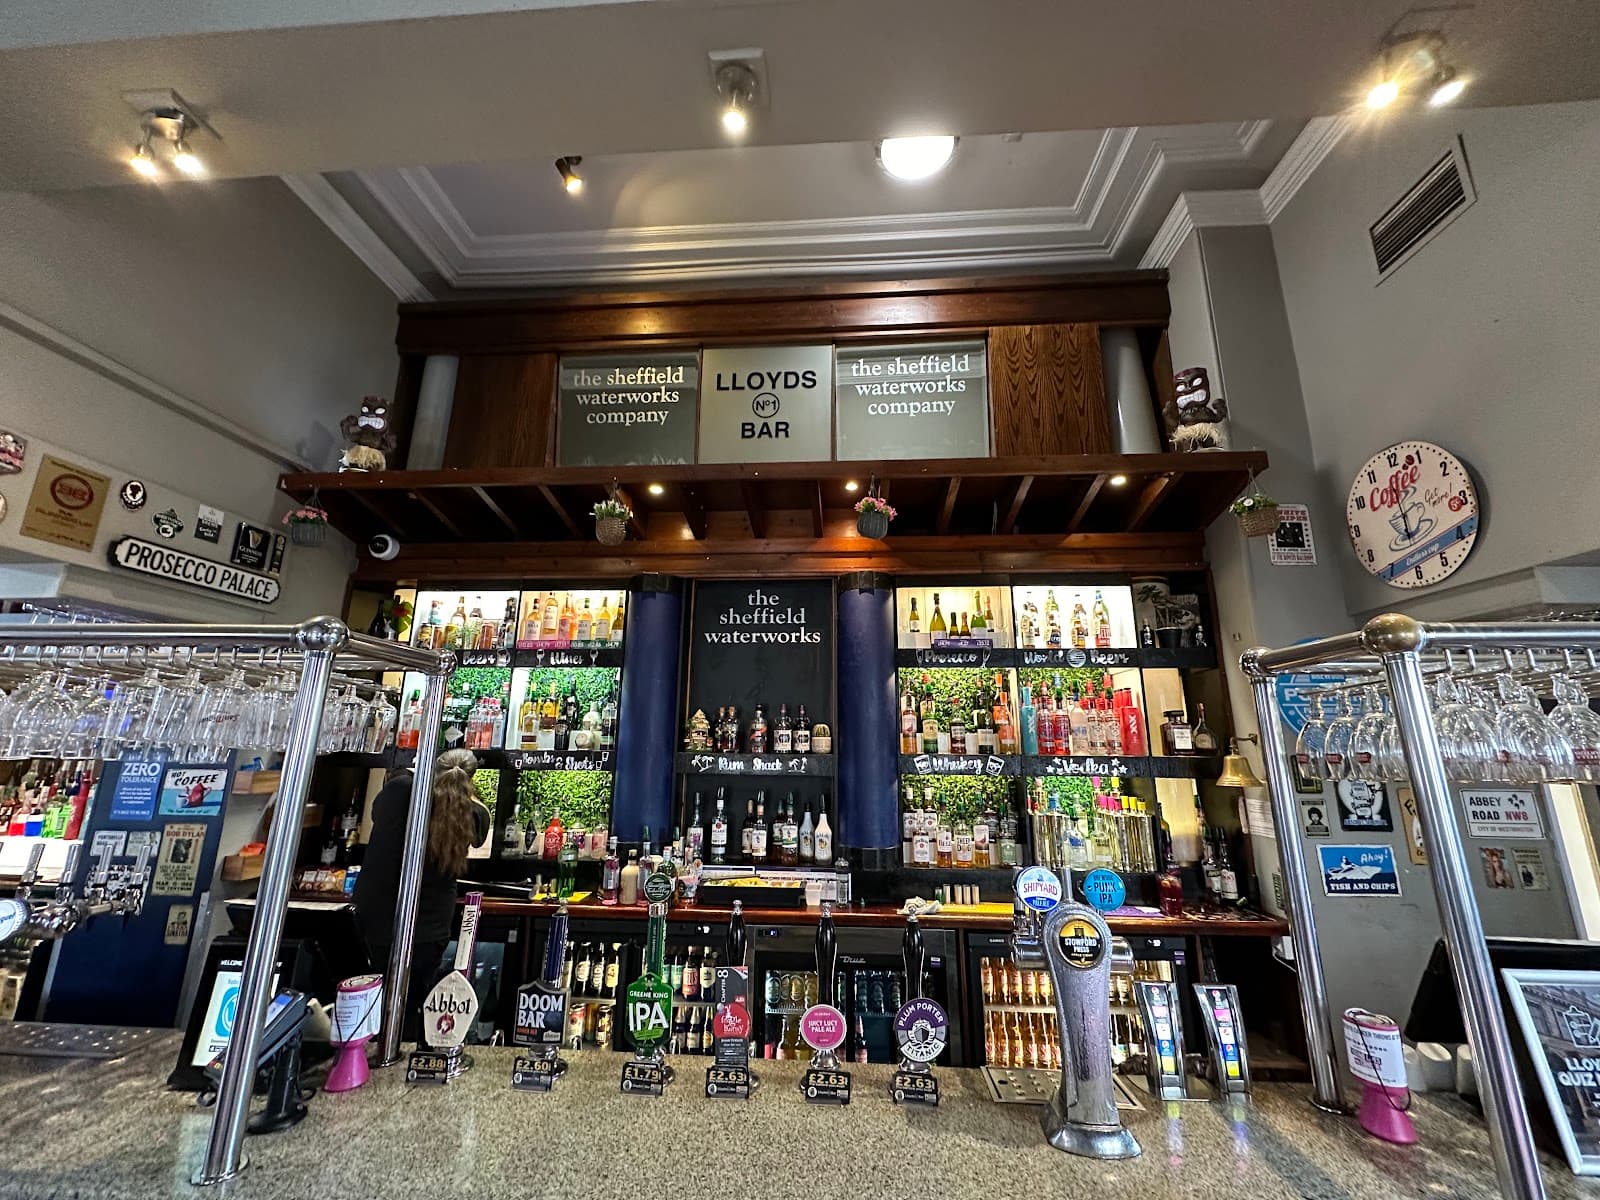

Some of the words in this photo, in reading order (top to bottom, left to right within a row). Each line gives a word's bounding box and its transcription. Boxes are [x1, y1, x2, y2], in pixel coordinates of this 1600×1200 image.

[850, 360, 882, 377] the
[886, 354, 970, 375] sheffield
[573, 370, 603, 387] the
[605, 366, 684, 385] sheffield
[715, 370, 818, 392] LLOYDS
[854, 374, 967, 396] waterworks
[576, 385, 680, 405] waterworks
[866, 397, 957, 418] company
[586, 406, 669, 427] company
[740, 420, 790, 440] BAR
[1386, 453, 1399, 468] 12
[1415, 450, 1422, 465] 1
[1440, 461, 1450, 477] 2
[1366, 470, 1377, 485] 11
[1369, 465, 1421, 512] Coffee
[1354, 496, 1366, 511] 10
[1458, 490, 1469, 506] 3
[1353, 524, 1361, 538] 9
[1455, 526, 1465, 541] 4
[1367, 549, 1375, 563] 8
[1439, 551, 1449, 567] 5
[124, 542, 218, 586] PROSECCO
[218, 568, 273, 600] PALACE
[1388, 563, 1395, 578] 7
[1414, 564, 1423, 580] 6
[747, 588, 780, 606] the
[719, 607, 807, 625] sheffield
[704, 626, 821, 644] waterworks
[550, 651, 585, 665] Wines
[924, 650, 979, 664] Prosecco
[1023, 650, 1065, 665] World
[1089, 650, 1130, 664] Beers
[121, 762, 161, 777] ZERO
[718, 757, 745, 771] Rum
[752, 757, 783, 771] Shack
[931, 757, 984, 774] Whiskey
[1062, 757, 1110, 774] Vodka
[120, 776, 158, 784] TOLERANCE
[171, 771, 187, 779] HOT
[174, 773, 219, 786] COFFEE
[1469, 796, 1502, 808] ABBEY
[1472, 810, 1501, 821] ROAD
[1504, 811, 1530, 821] NW8
[1360, 848, 1389, 865] Ahoy!
[1023, 882, 1059, 897] SHIPYARD
[1093, 881, 1117, 894] PUNK
[1330, 882, 1352, 891] FISH
[1353, 882, 1370, 890] AND
[1371, 882, 1397, 890] CHIPS
[1099, 894, 1113, 904] IPA
[462, 909, 478, 936] Abbot
[1064, 937, 1098, 947] STOWFORD
[220, 959, 244, 967] WELCOME
[717, 969, 730, 979] 8
[519, 992, 564, 1012] DOOM
[629, 990, 652, 999] GREENE
[424, 991, 473, 1015] Abbot
[517, 1009, 546, 1030] BAR
[628, 1001, 670, 1032] IPA
[897, 1004, 917, 1027] PLUM
[916, 1002, 944, 1023] PORTER
[808, 1020, 823, 1028] JUICY
[906, 1043, 941, 1060] TITANIC
[410, 1057, 445, 1070] £2.88
[515, 1060, 550, 1072] £2.60
[624, 1068, 660, 1080] £1.79
[708, 1070, 746, 1082] £2.63
[808, 1072, 846, 1085] £2.63
[895, 1075, 933, 1088] £2.63
[1558, 1072, 1598, 1088] QUIZ
